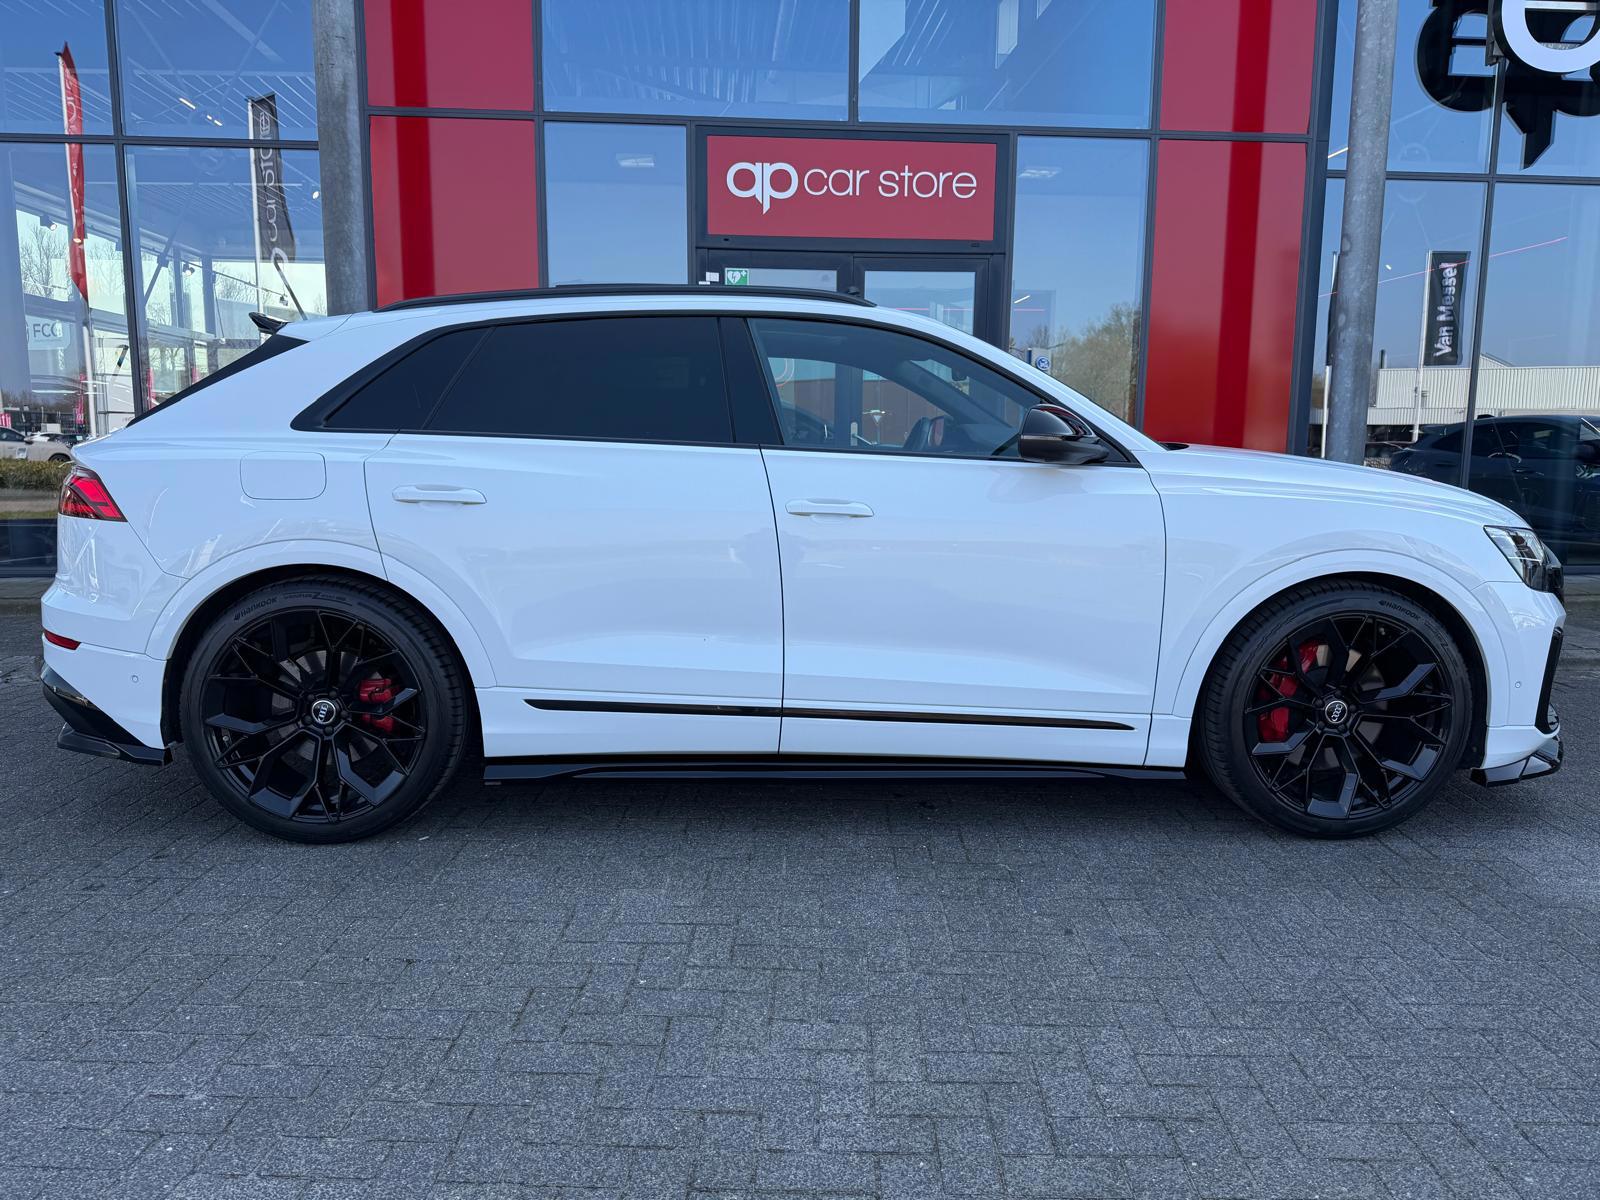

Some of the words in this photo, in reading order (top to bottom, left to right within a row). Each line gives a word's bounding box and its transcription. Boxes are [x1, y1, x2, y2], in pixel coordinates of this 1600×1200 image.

[726, 161, 798, 215] ap
[804, 168, 870, 196] car
[878, 165, 977, 199] store
[1433, 326, 1453, 357] Van
